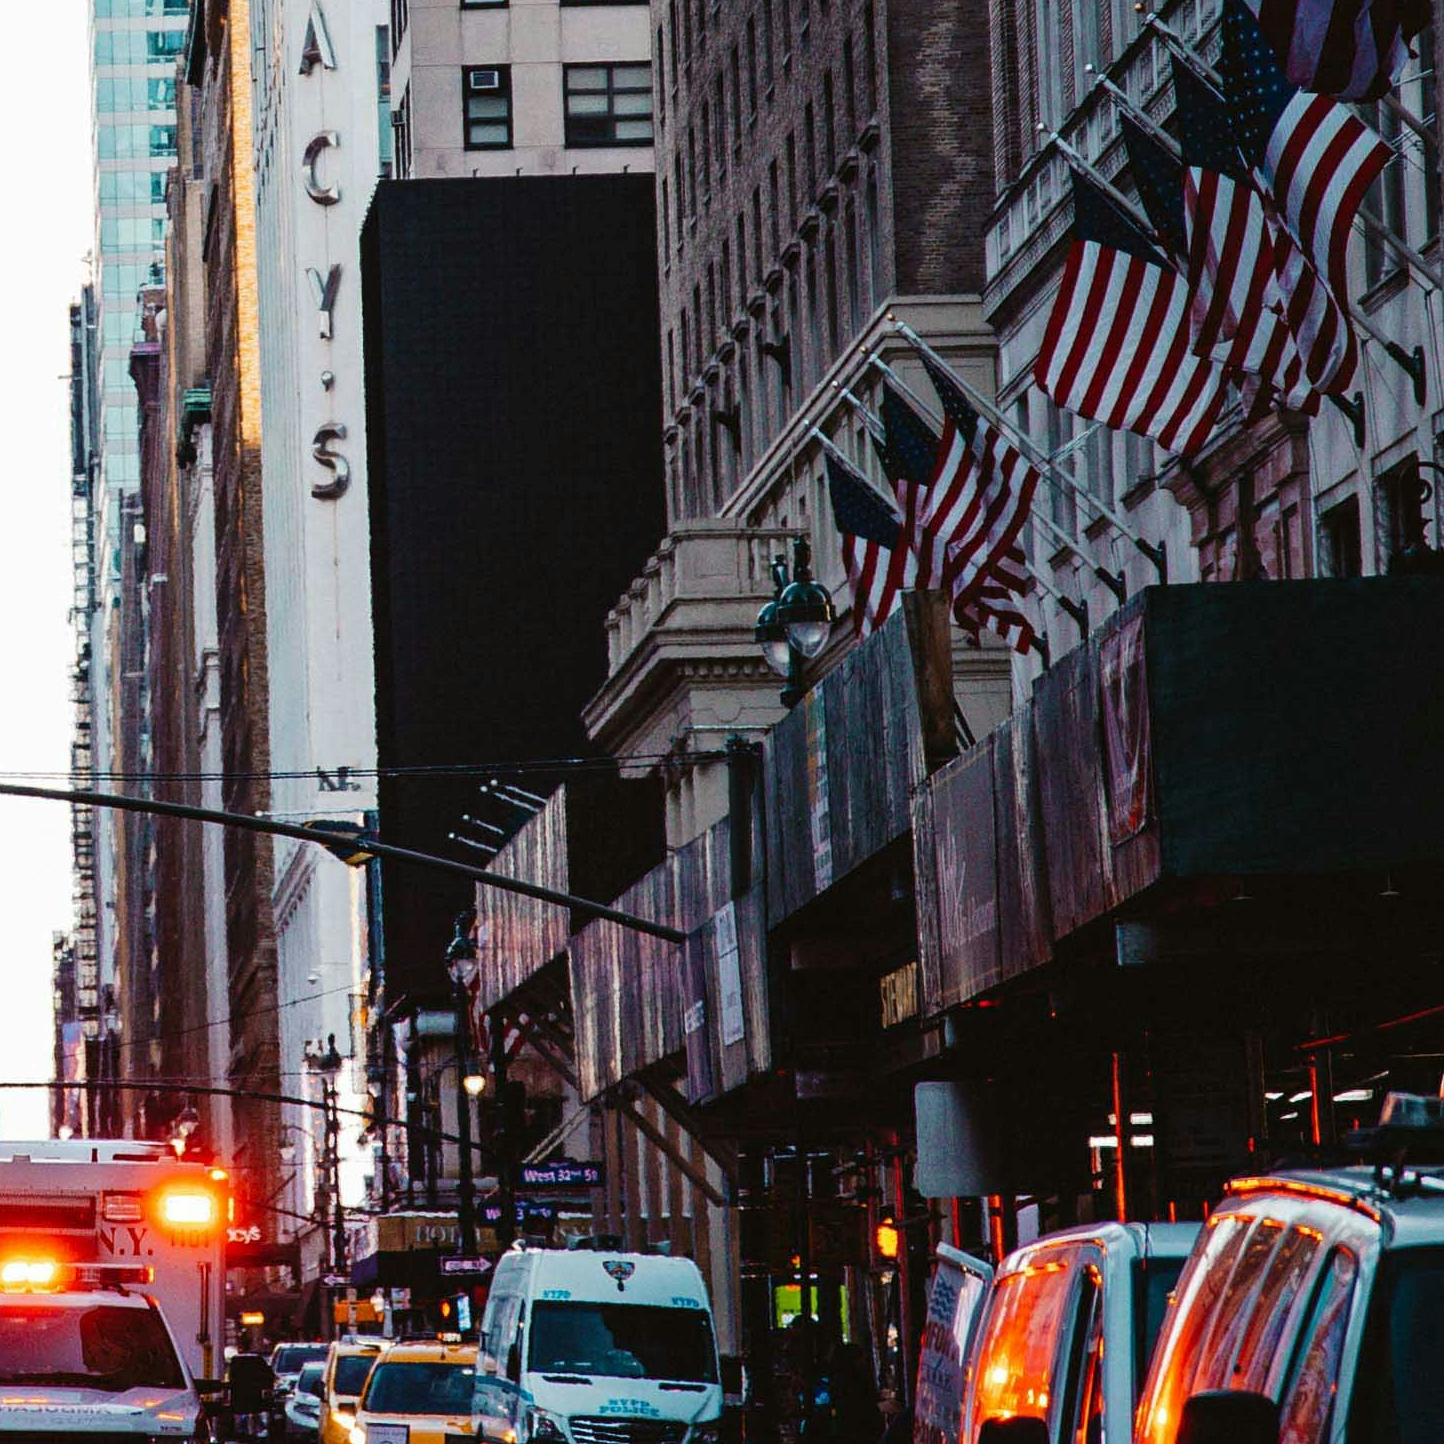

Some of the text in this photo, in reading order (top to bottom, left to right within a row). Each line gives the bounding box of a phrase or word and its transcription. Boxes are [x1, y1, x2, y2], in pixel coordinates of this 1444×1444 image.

[523, 1169, 555, 1182] West
[99, 1227, 153, 1256] N.Y.
[599, 1406, 660, 1417] POLICE
